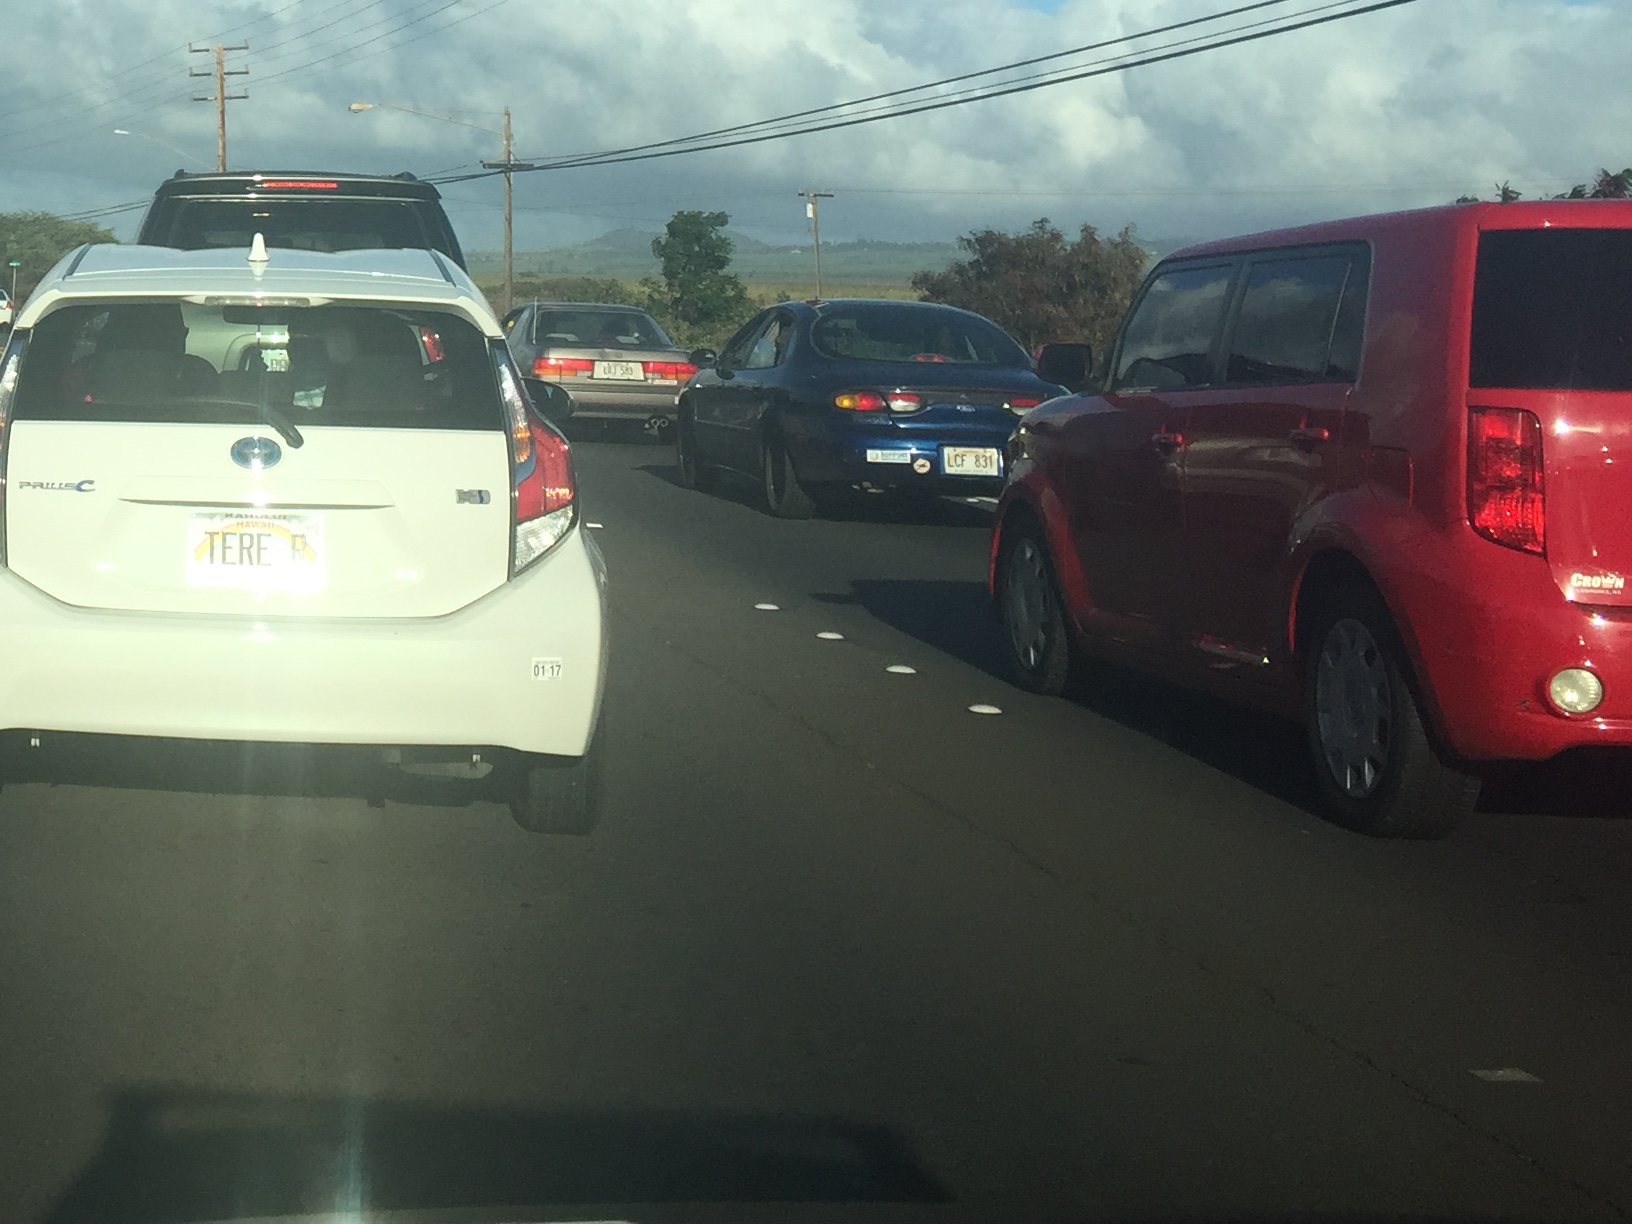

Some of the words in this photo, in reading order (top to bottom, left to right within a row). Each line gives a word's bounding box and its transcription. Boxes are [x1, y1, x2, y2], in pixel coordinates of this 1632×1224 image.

[947, 453, 967, 468] LCF
[974, 454, 993, 469] 831
[236, 520, 275, 529] HAWAII
[204, 531, 272, 566] TERE
[533, 664, 545, 677] 01
[549, 664, 562, 677] 17
